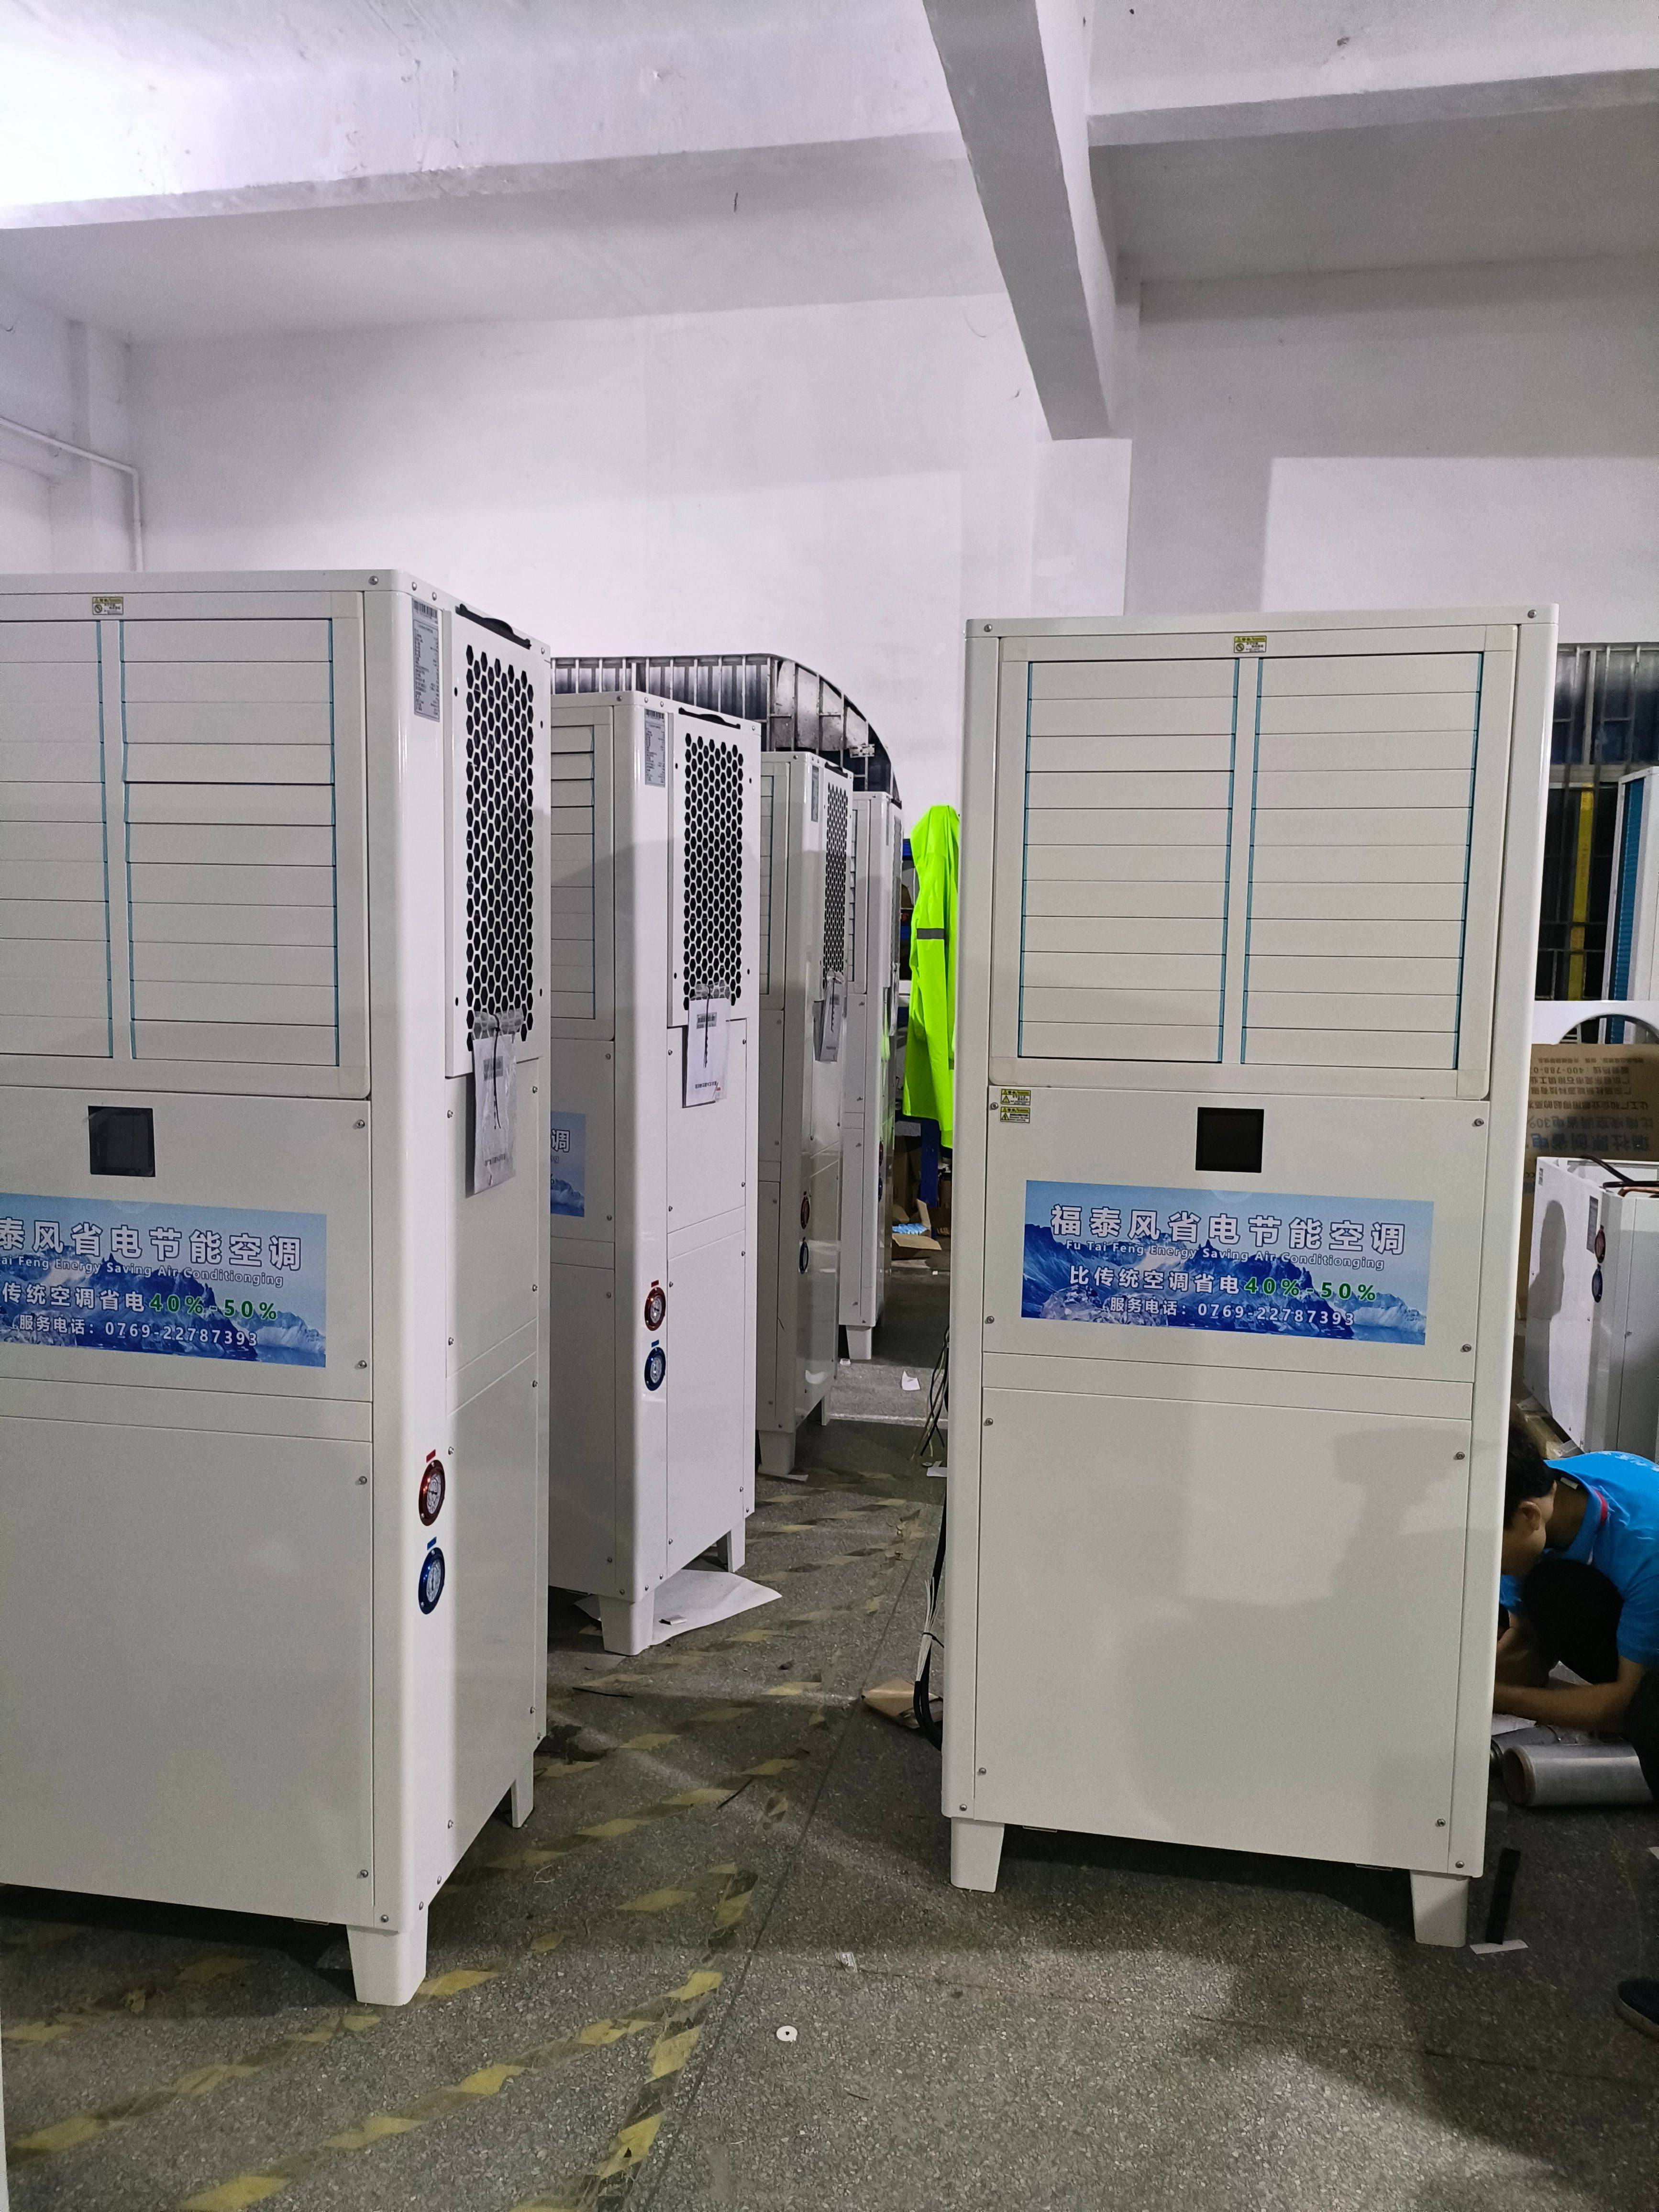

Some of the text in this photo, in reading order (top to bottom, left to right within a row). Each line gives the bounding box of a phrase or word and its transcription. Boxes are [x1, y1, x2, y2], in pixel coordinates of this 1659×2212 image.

[1051, 1204, 1405, 1255] 福泰风省电节能空调
[1066, 1239, 1384, 1271] Fu Tai Feng Energy Saving Air Conditionging
[18, 1256, 49, 1270] Feng
[55, 1259, 100, 1274] Energy
[106, 1262, 152, 1278] Saving
[158, 1266, 178, 1277] Air
[184, 1267, 284, 1288] Conditionging
